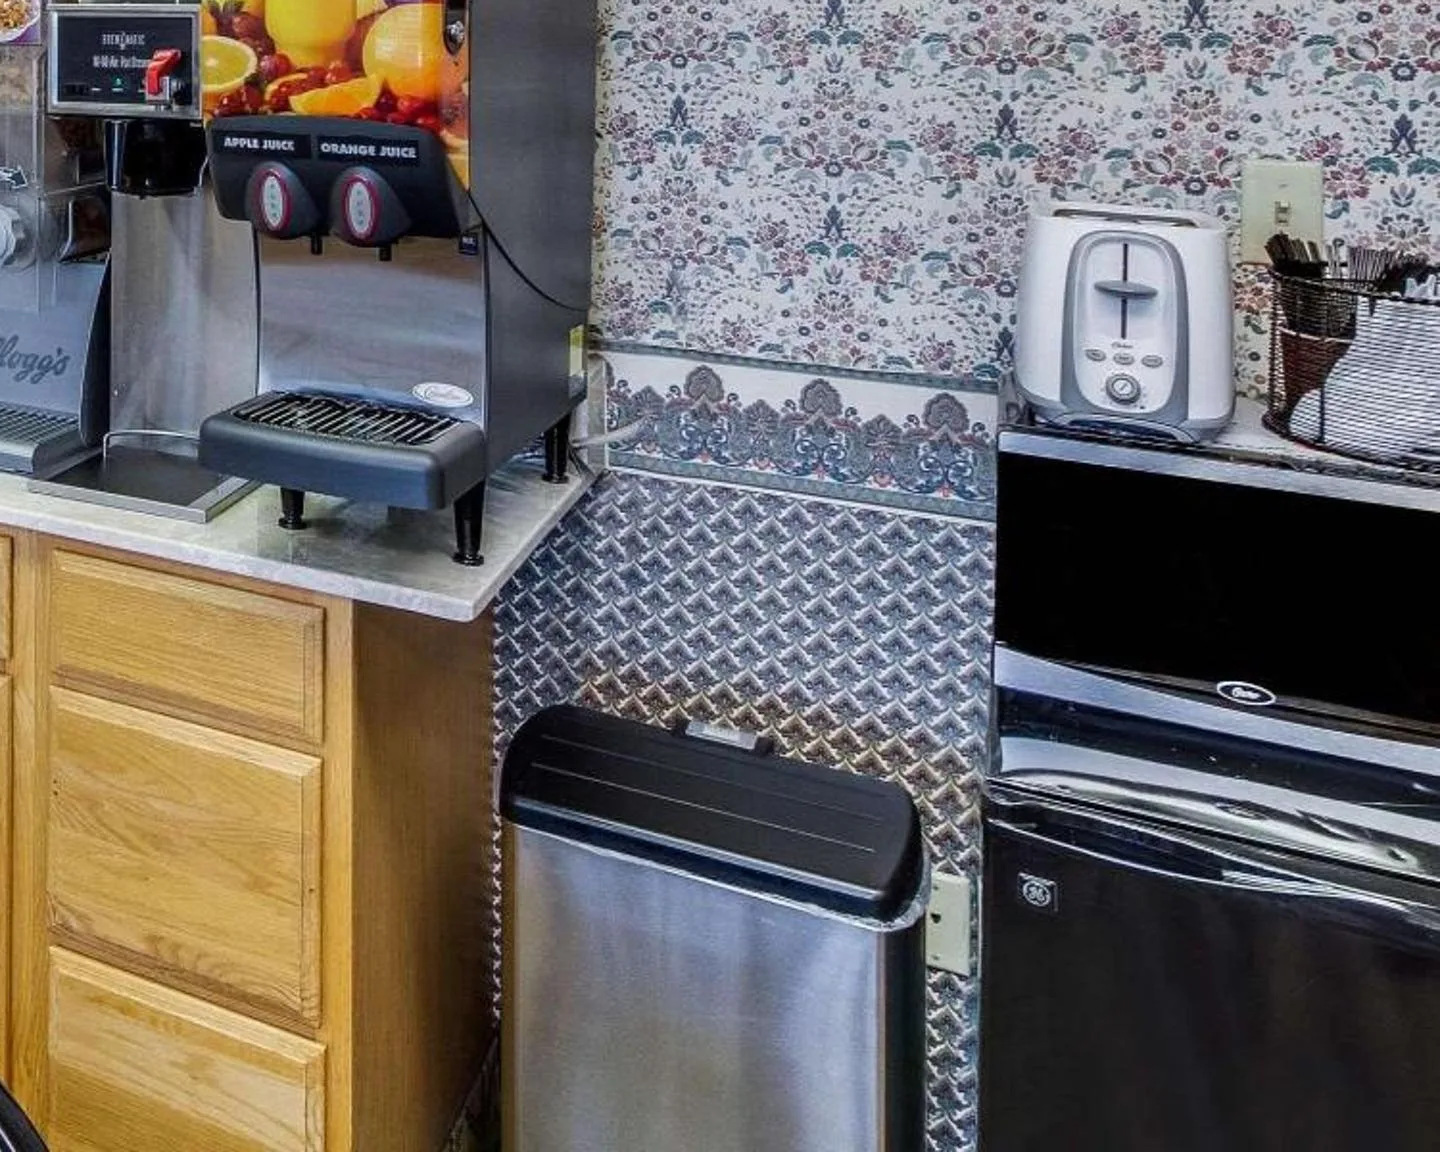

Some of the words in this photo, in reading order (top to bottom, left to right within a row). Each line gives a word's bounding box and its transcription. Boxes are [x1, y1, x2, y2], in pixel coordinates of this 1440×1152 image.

[224, 136, 259, 149] APPLE
[262, 139, 295, 151] JUICE
[320, 142, 377, 157] ORANGE
[380, 146, 417, 159] JUICE
